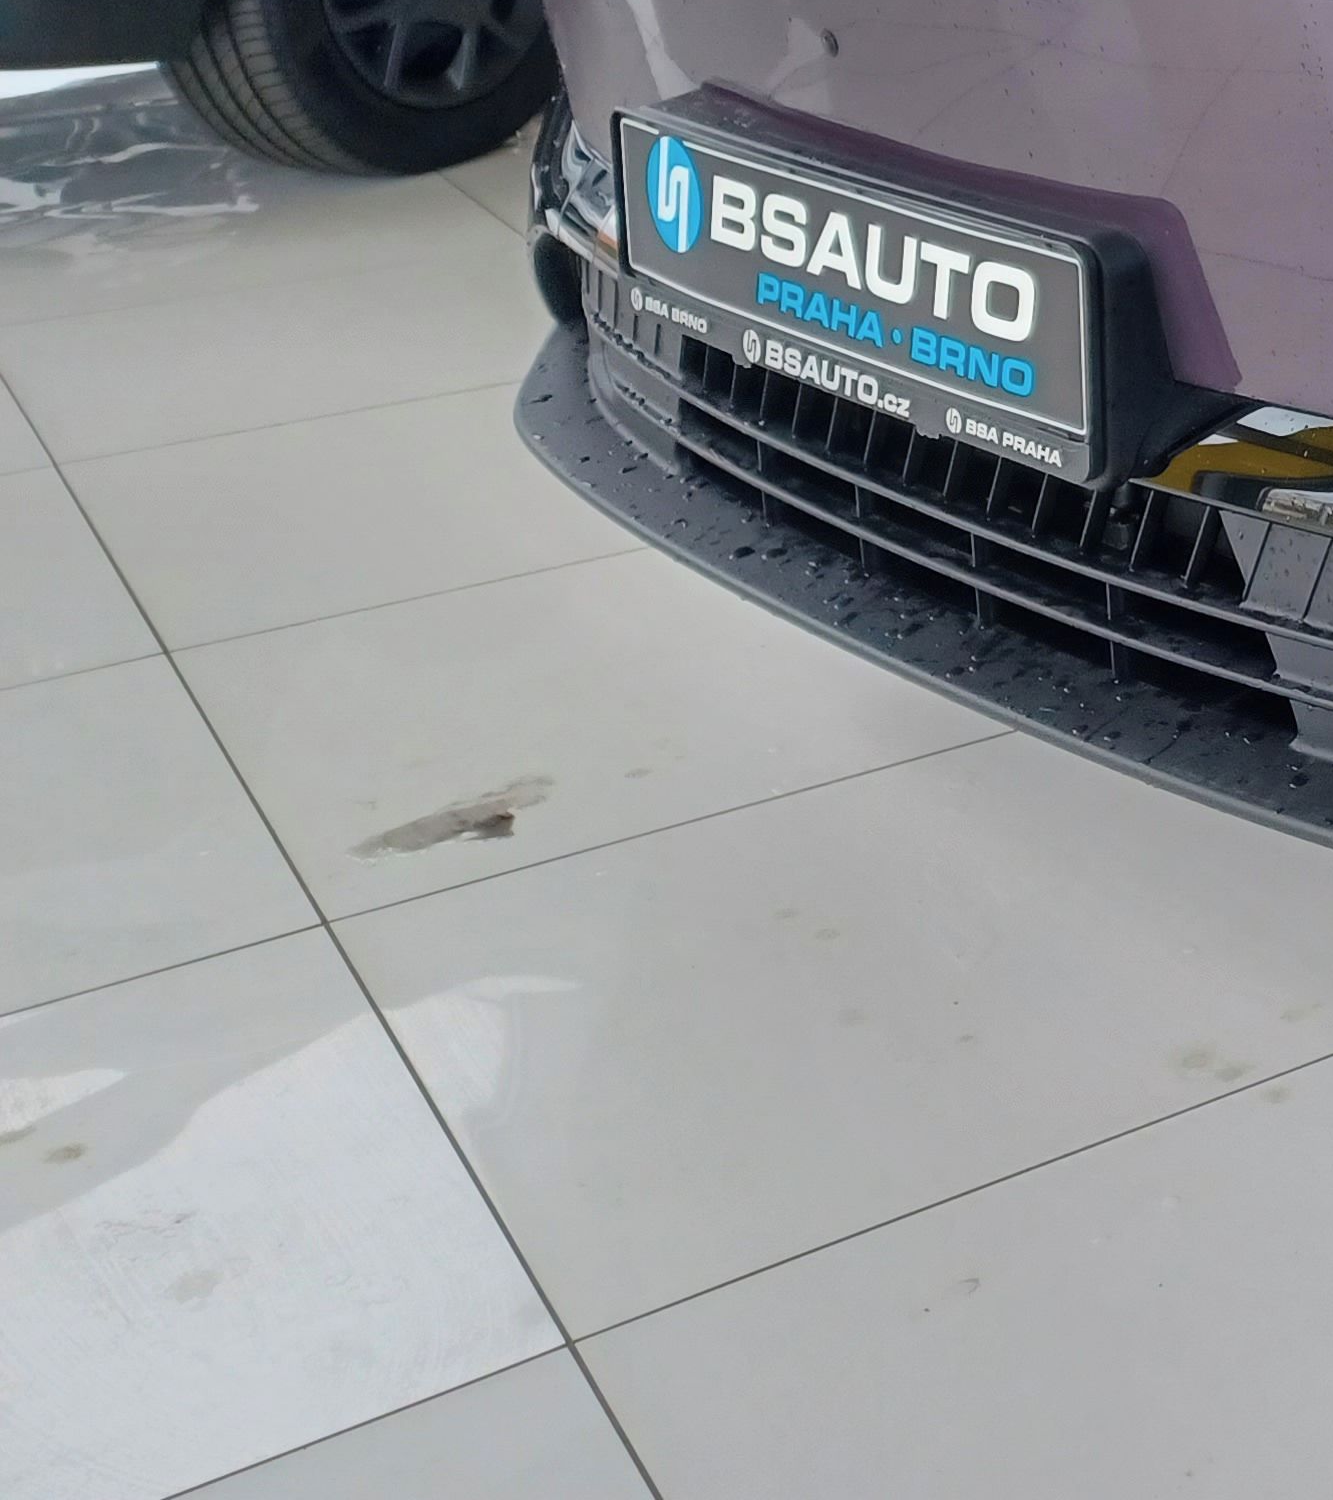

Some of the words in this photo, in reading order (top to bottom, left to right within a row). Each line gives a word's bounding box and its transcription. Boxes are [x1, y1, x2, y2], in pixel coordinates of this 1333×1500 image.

[710, 175, 1035, 342] BSAUTO
[671, 307, 707, 334] BRNO
[757, 271, 883, 348] PRAHA
[910, 326, 1035, 397] BRNO
[764, 339, 911, 418] BSAUTO.cz
[1002, 431, 1063, 468] PRAHA
